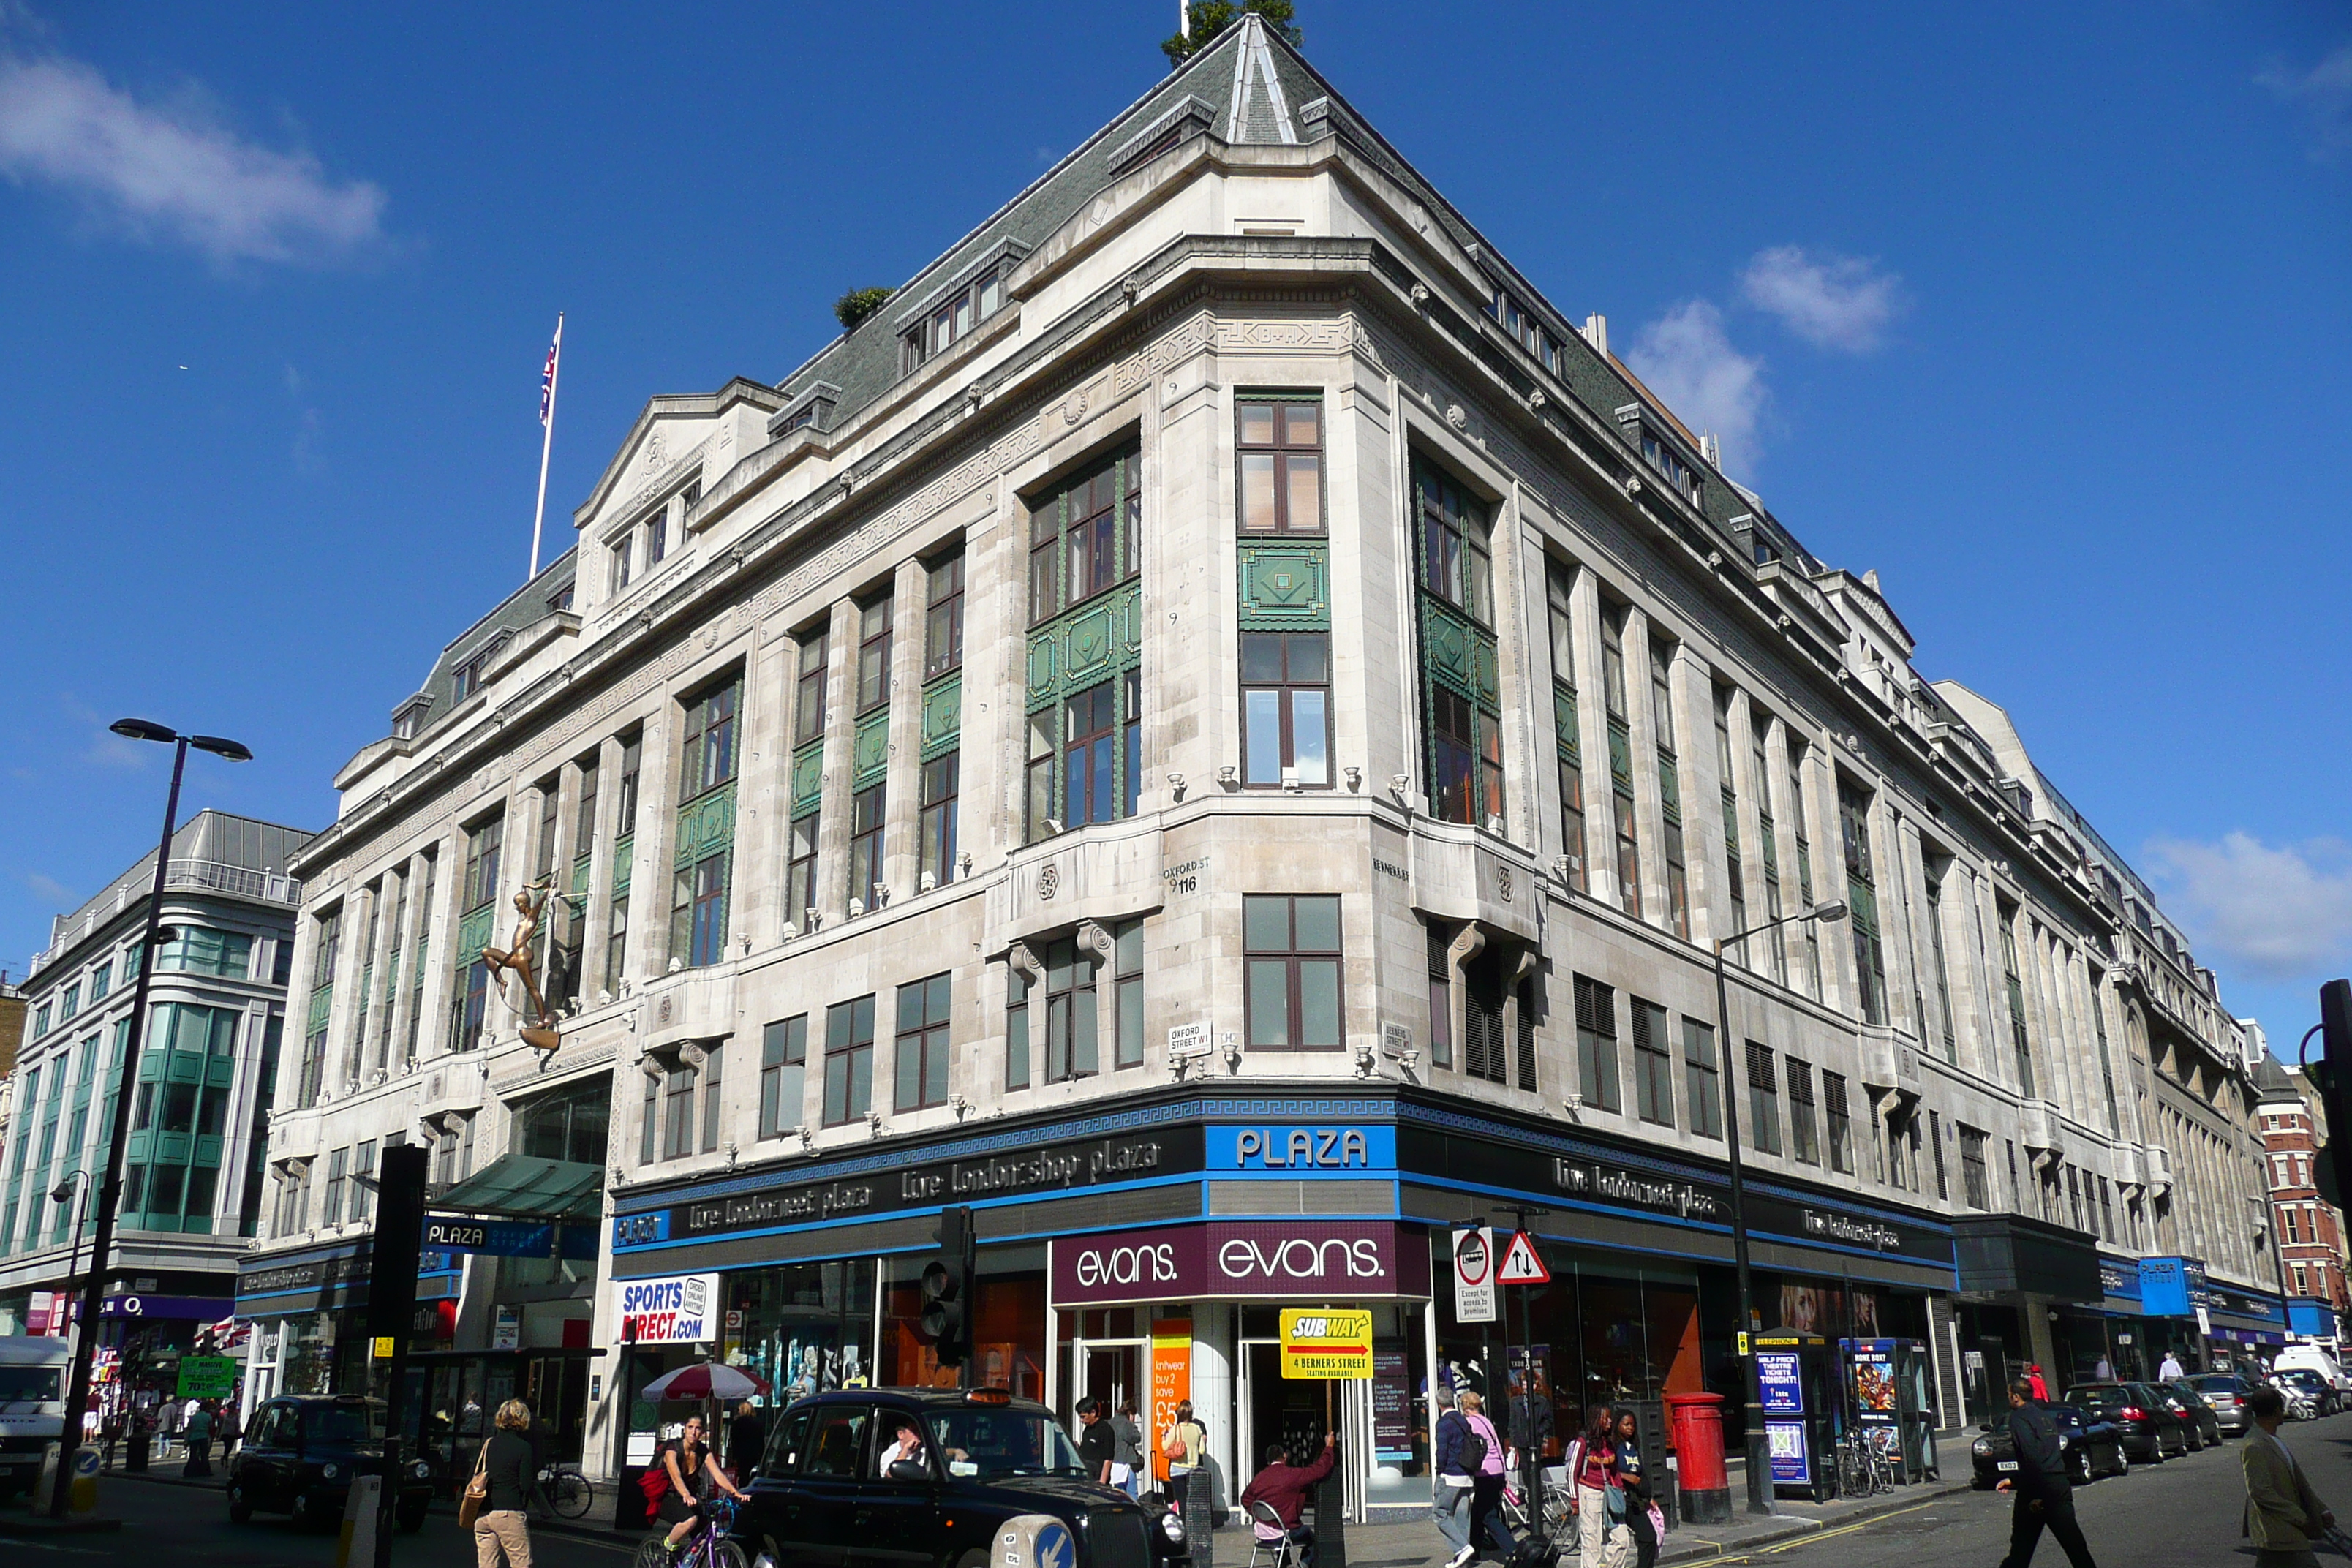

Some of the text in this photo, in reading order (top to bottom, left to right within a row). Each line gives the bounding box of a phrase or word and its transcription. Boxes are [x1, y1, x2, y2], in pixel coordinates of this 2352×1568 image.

[1172, 1026, 1199, 1039] OXFORD
[1387, 1025, 1406, 1039] BERNERS
[1172, 1036, 1196, 1049] STREET
[1387, 1036, 1401, 1047] STREET
[1236, 1128, 1368, 1168] PLAZA
[902, 1171, 942, 1201] live
[1090, 1140, 1160, 1186] plaza
[821, 1183, 872, 1219] plaza
[429, 1225, 483, 1245] PLAZA
[492, 1229, 543, 1240] OXFORD
[491, 1239, 541, 1249] STREET
[690, 1282, 704, 1292] ORDER
[623, 1281, 683, 1313] SPORTS
[687, 1292, 704, 1302] ONLINE
[1461, 1289, 1479, 1298] Except
[685, 1300, 704, 1312] ANYTIME
[1463, 1298, 1488, 1307] access to
[1464, 1308, 1488, 1316] premises
[620, 1311, 703, 1342] DRECT.COM
[1292, 1315, 1368, 1339] SUBWAY
[1294, 1358, 1299, 1368] 4
[1301, 1357, 1335, 1369] BERNERS
[1338, 1358, 1366, 1369] STREET
[1872, 1354, 1886, 1362] BOX?
[1156, 1361, 1186, 1371] knitwear
[1156, 1373, 1175, 1385] buy 2
[1760, 1376, 1797, 1384] TONIGHT!
[1156, 1388, 1174, 1397] save
